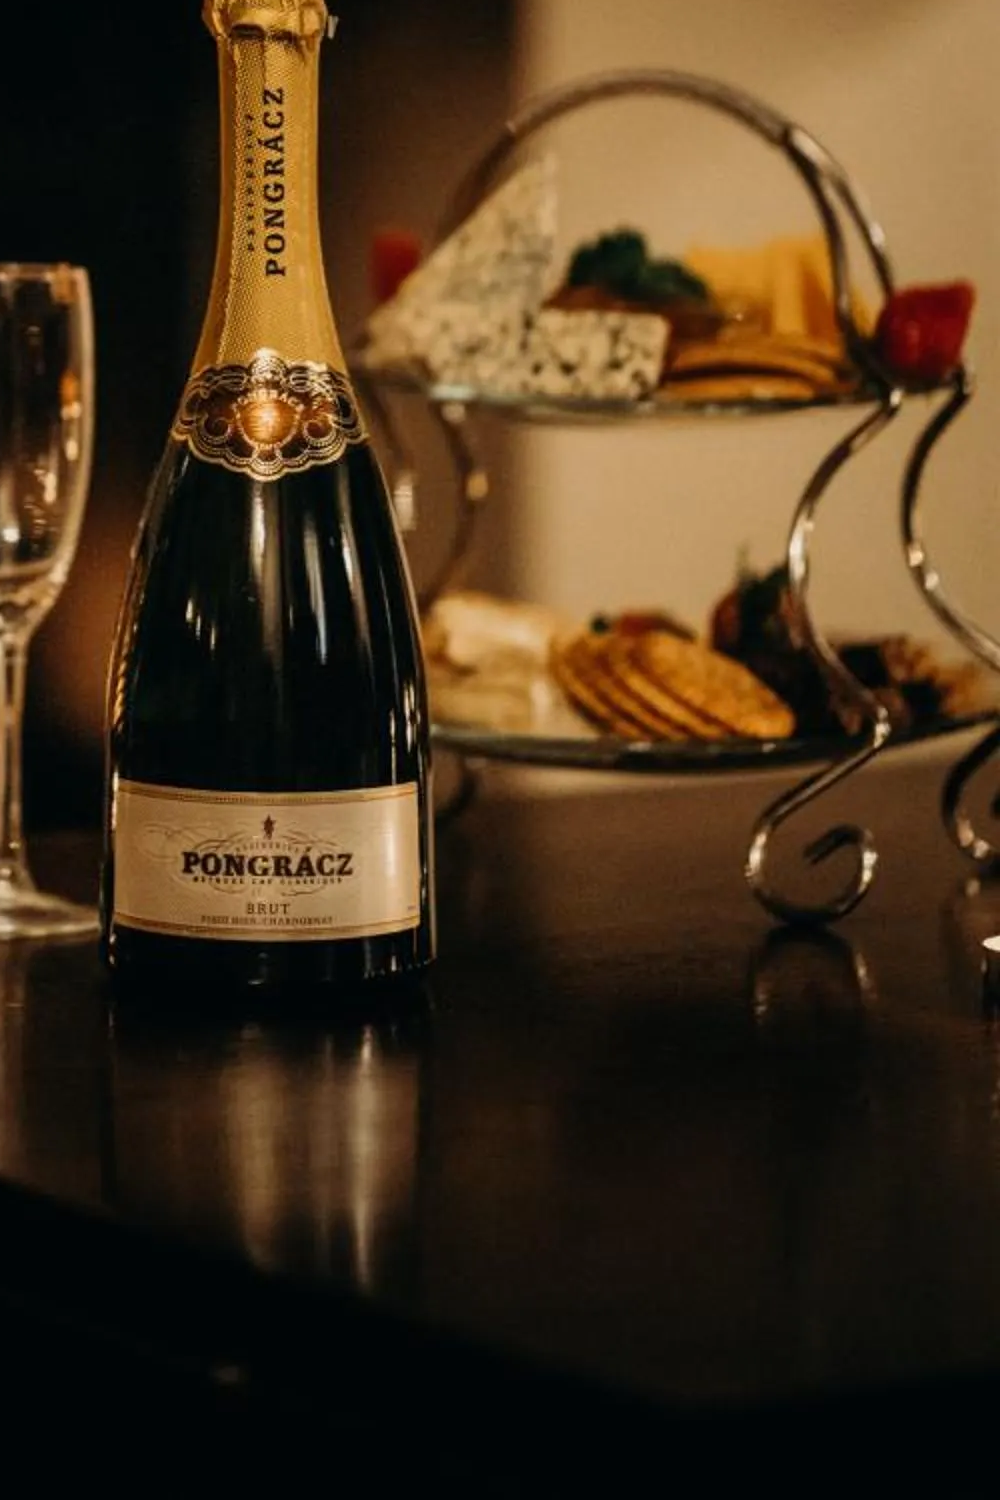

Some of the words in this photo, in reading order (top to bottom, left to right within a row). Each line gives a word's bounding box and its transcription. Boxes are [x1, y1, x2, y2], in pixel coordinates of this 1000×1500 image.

[257, 86, 286, 277] PONGRÁCZ
[181, 846, 353, 878] PONGRÁCZ
[247, 903, 291, 915] BRUT
